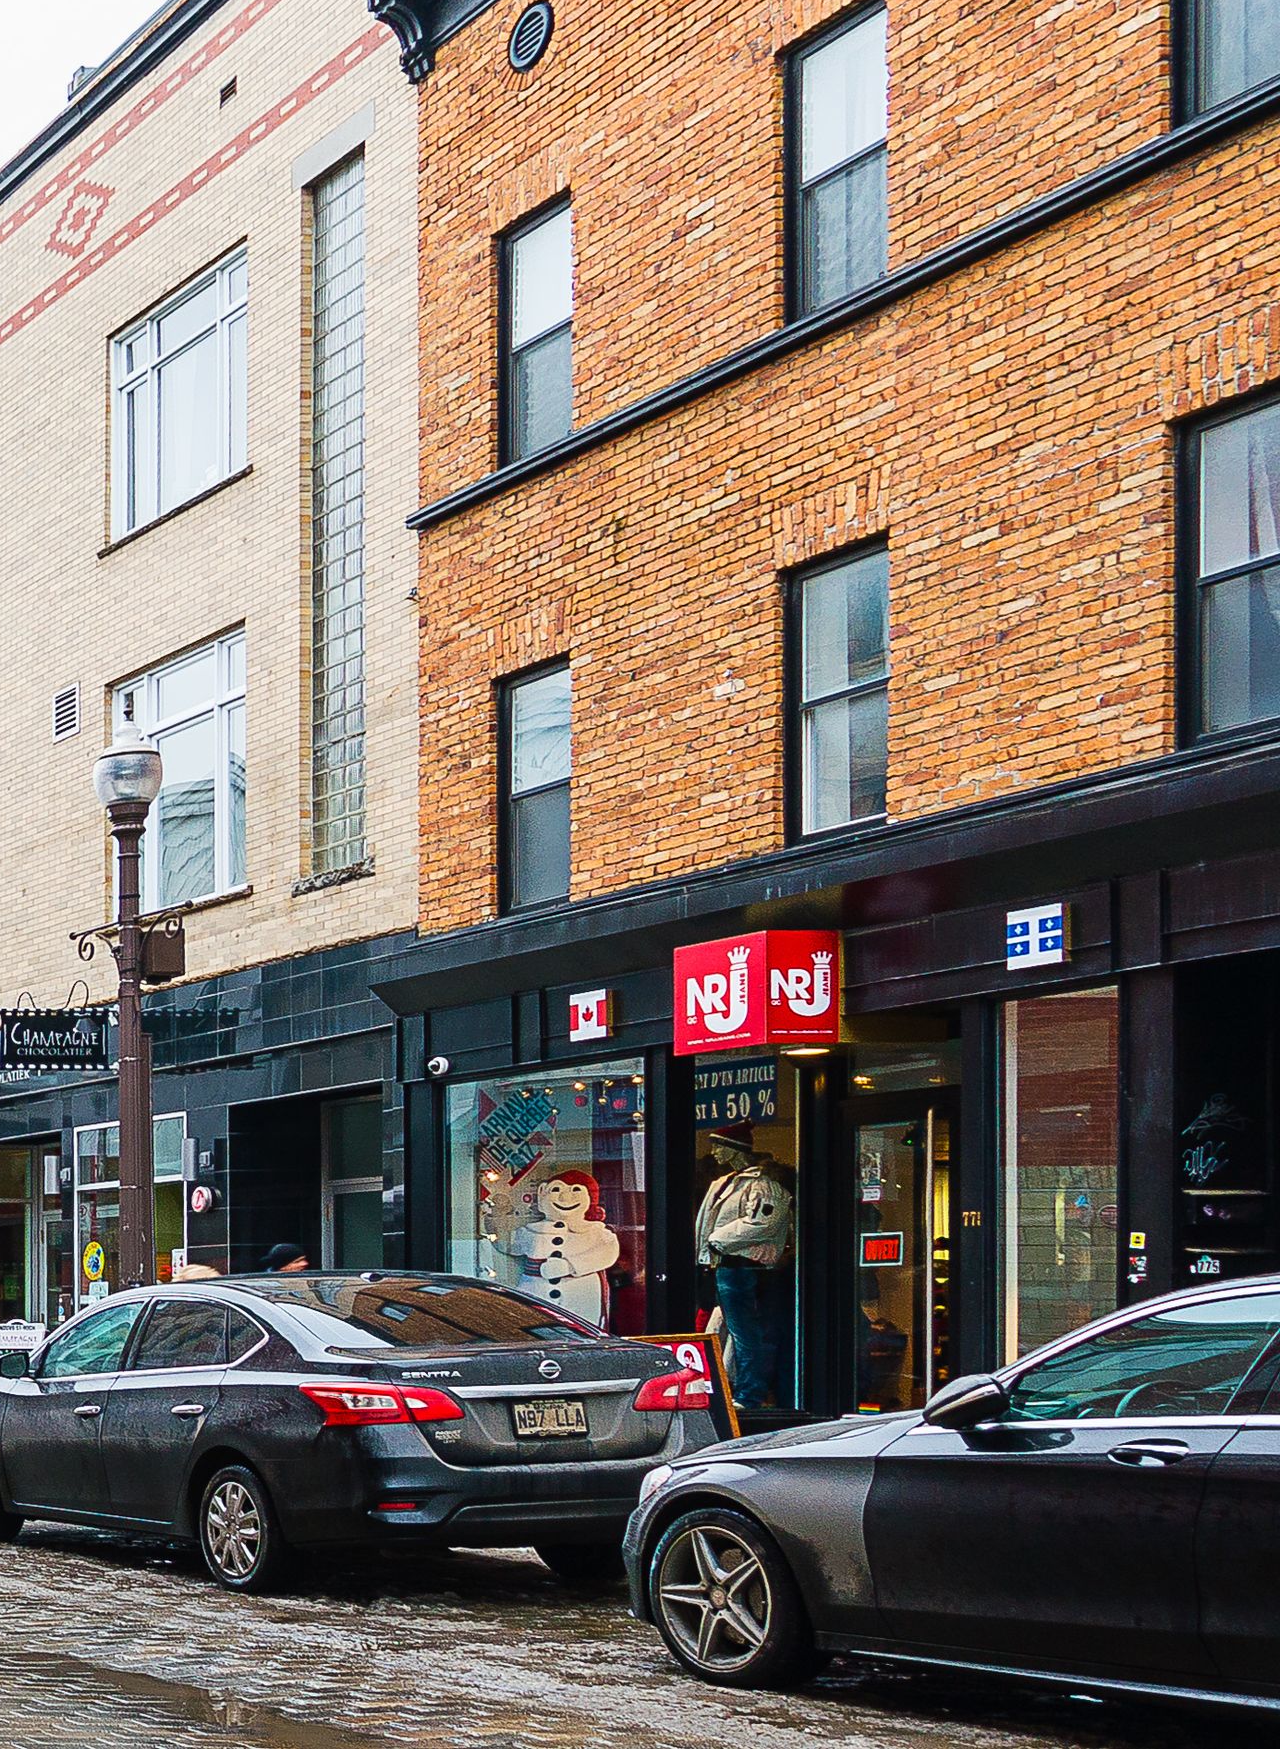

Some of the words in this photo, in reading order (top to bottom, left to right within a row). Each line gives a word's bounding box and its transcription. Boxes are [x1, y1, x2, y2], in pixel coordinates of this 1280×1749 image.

[686, 962, 749, 1034] NRJ
[770, 963, 831, 1017] NRJ
[10, 1022, 99, 1047] CHAMPAGNE
[17, 1047, 93, 1056] CHOCOLATIER
[735, 1064, 776, 1085] ARTICLE
[726, 1092, 751, 1119] 50
[487, 1136, 513, 1163] DE
[865, 1239, 899, 1260] OUVERT
[1197, 1259, 1220, 1273] 775
[401, 1369, 462, 1379] SENTRA
[516, 1410, 545, 1429] N97
[554, 1408, 584, 1427] LLA
